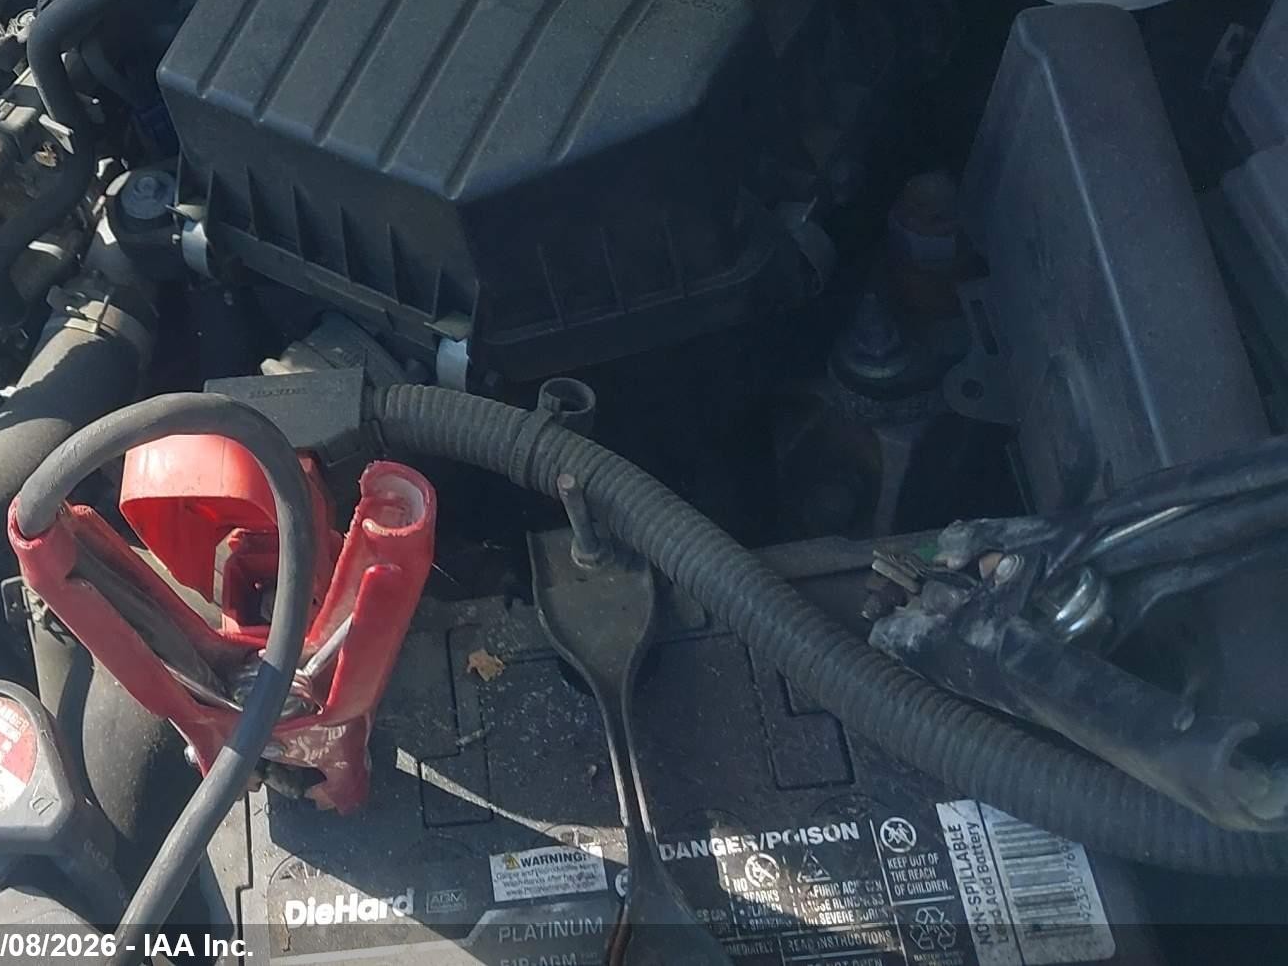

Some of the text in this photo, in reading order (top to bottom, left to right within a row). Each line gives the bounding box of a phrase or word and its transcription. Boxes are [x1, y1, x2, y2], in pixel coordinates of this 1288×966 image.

[660, 821, 860, 862] DANGER/POISON
[966, 820, 989, 877] Battery
[520, 850, 587, 868] WARNING:
[887, 852, 940, 870] KEEP OUT OF
[890, 866, 937, 883] THE REACH
[947, 823, 994, 946] NON-SPILLABLE
[894, 879, 952, 896] OF CHILDREN.
[979, 878, 1000, 906] Acid
[284, 887, 415, 928] DieHard
[819, 910, 854, 925] SEVERE
[498, 916, 604, 943] PLATINUM
[817, 929, 893, 949] INSTRUCTIONS
